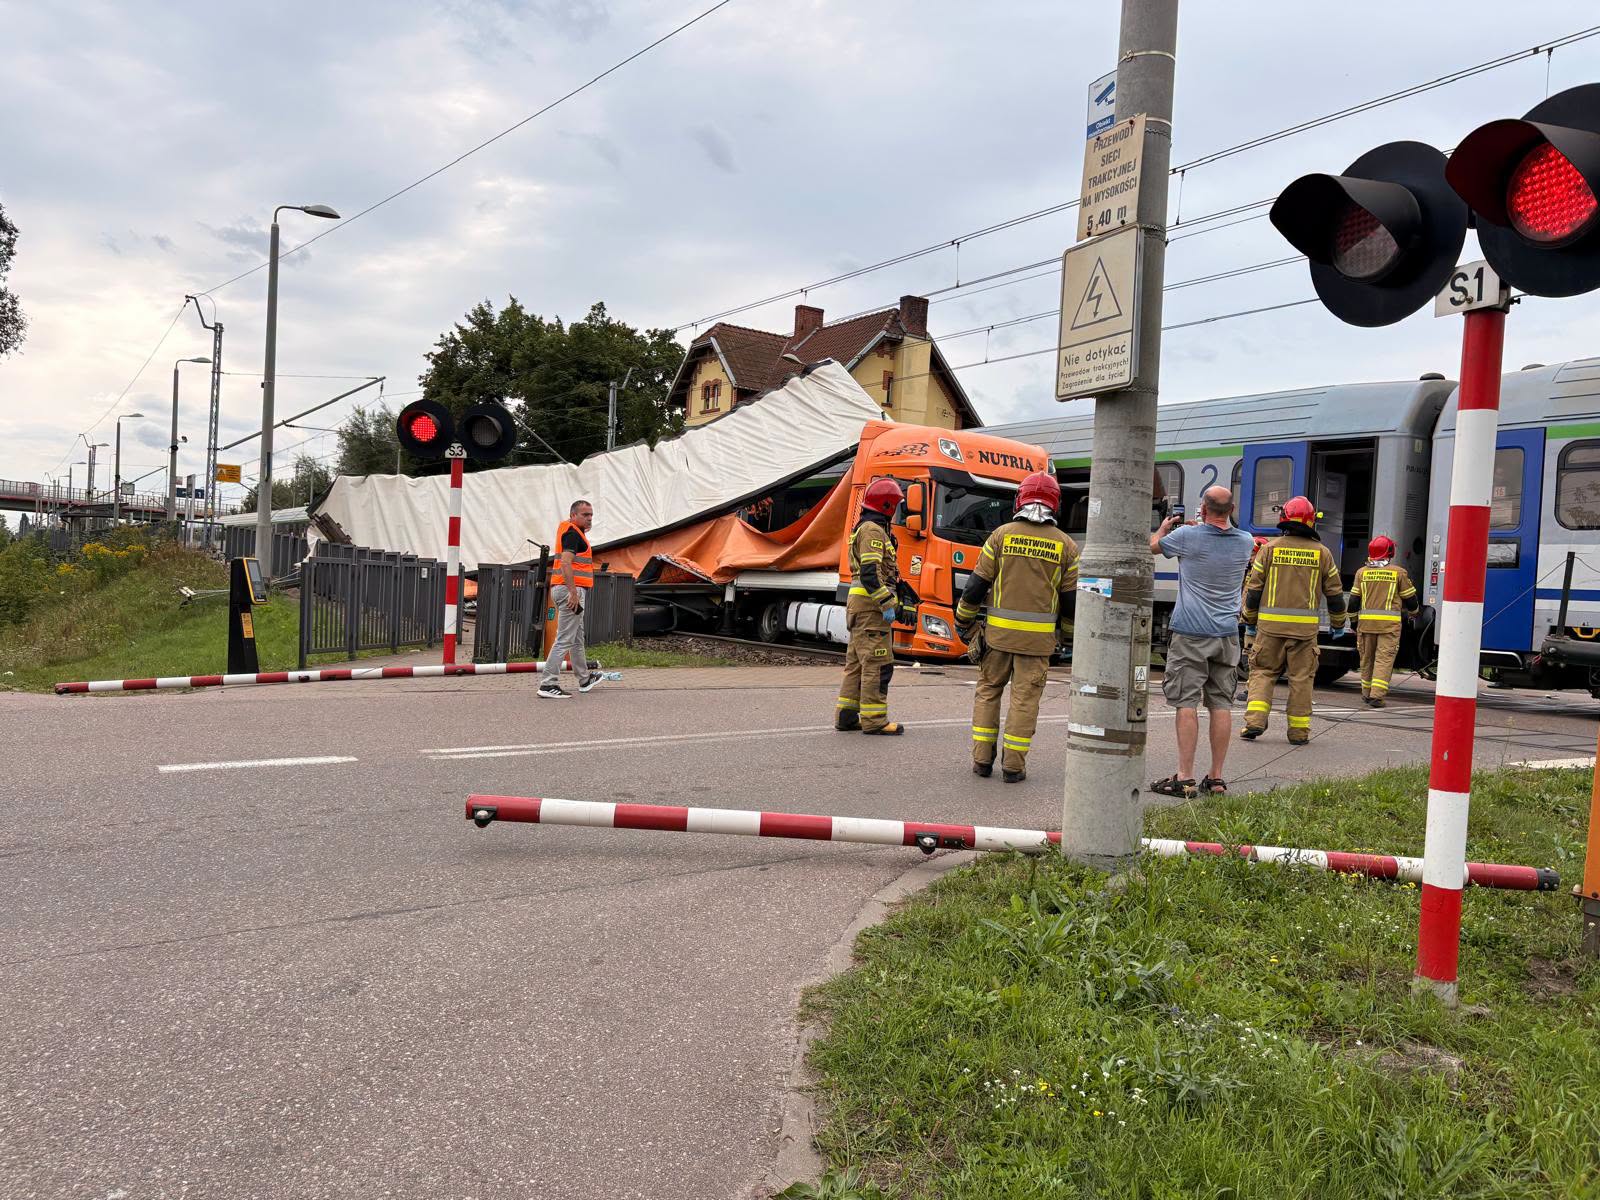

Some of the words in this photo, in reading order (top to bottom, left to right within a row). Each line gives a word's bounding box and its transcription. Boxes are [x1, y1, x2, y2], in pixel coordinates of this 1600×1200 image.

[1093, 125, 1135, 153] PRZEWODY
[1100, 148, 1121, 167] SIECI
[1087, 158, 1137, 189] TRAKCYJNEJ
[1081, 195, 1092, 209] NA
[1093, 176, 1138, 204] WYSOKOŚCI
[1449, 266, 1485, 307] S1
[1064, 353, 1080, 367] Nie
[1085, 341, 1126, 362] dotykać
[1095, 373, 1105, 382] dla
[978, 450, 1034, 472] NUTRIA
